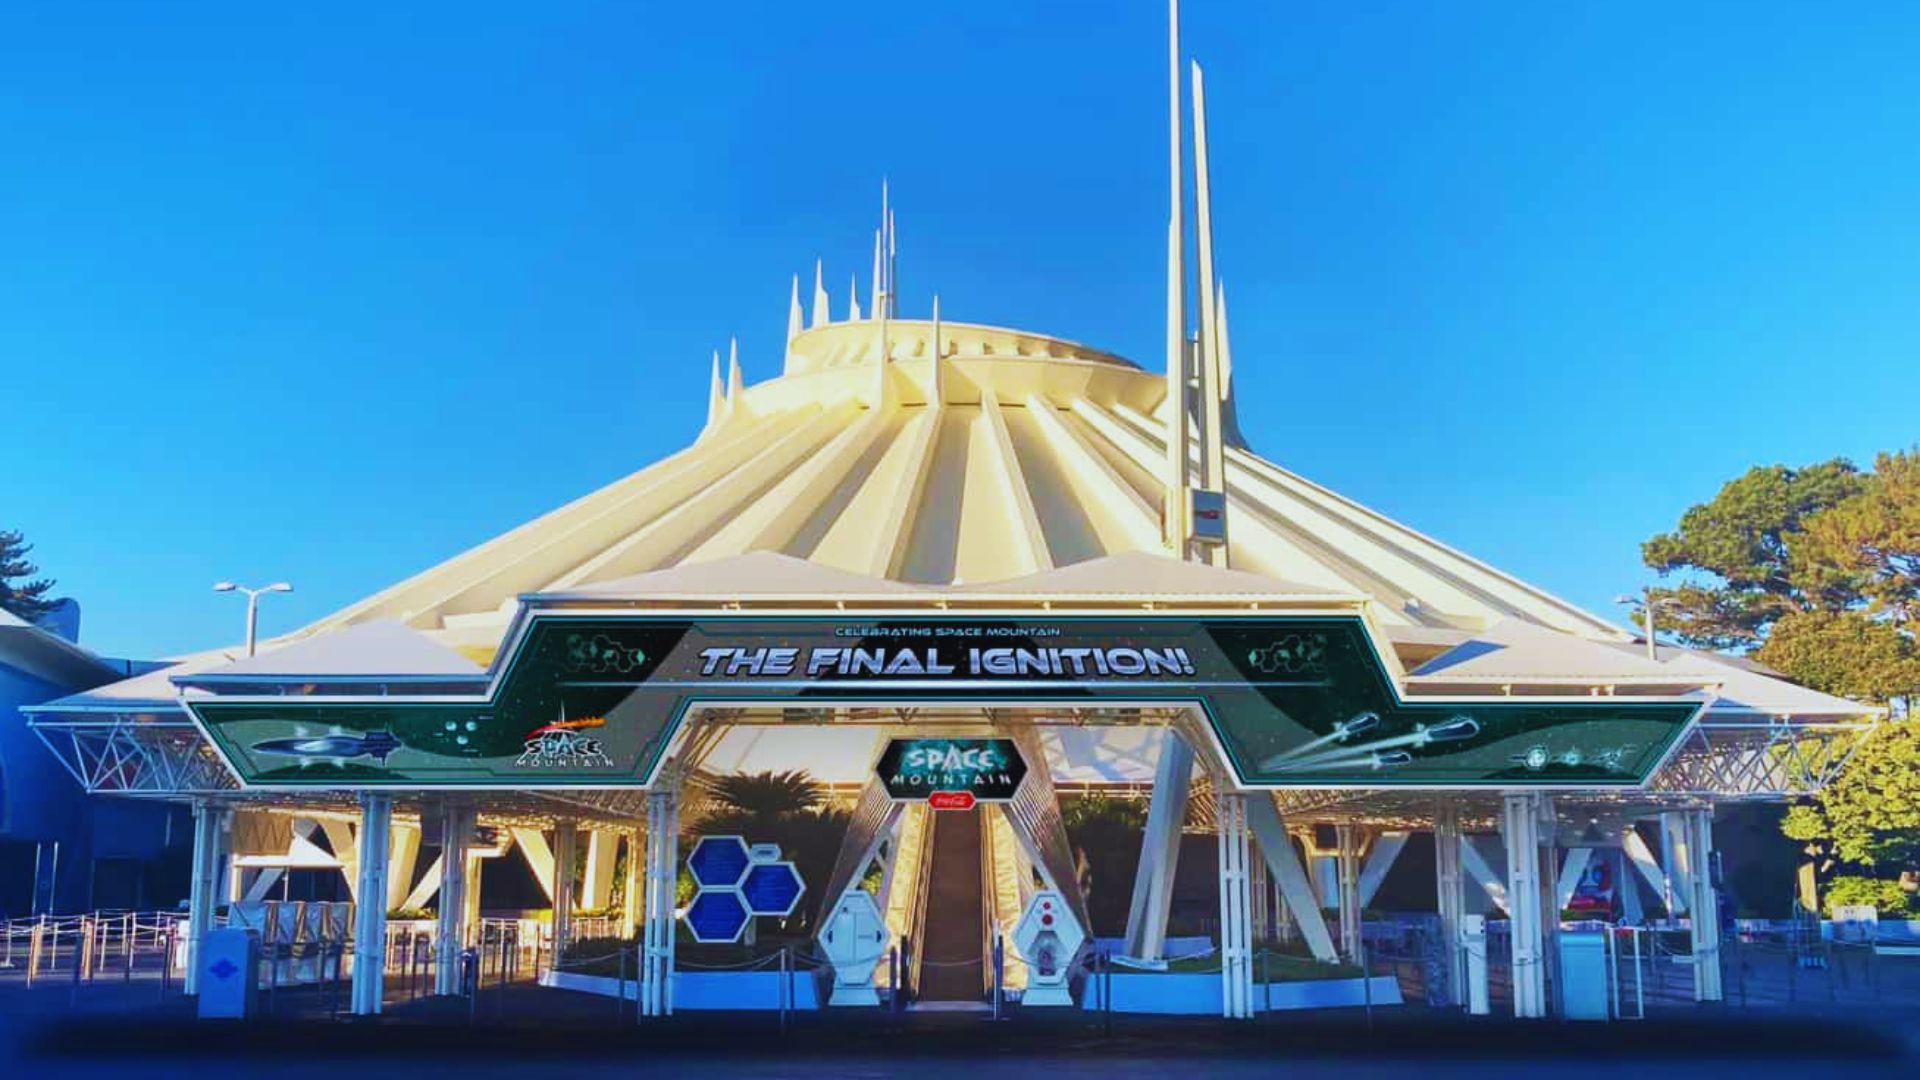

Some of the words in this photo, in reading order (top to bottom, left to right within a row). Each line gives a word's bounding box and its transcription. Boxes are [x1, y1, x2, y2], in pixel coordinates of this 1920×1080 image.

[835, 627, 931, 637] CELEBRATING
[935, 627, 982, 637] SPACE
[986, 627, 1061, 637] MOUNTAIN
[699, 647, 800, 675] THE
[807, 647, 956, 675] FINAL
[968, 647, 1197, 675] IGNITION!
[524, 732, 602, 758] SPACE
[515, 758, 615, 767] MOUNTAIN
[906, 744, 995, 771] SPACE
[890, 773, 1012, 786] MOUNTAIN
